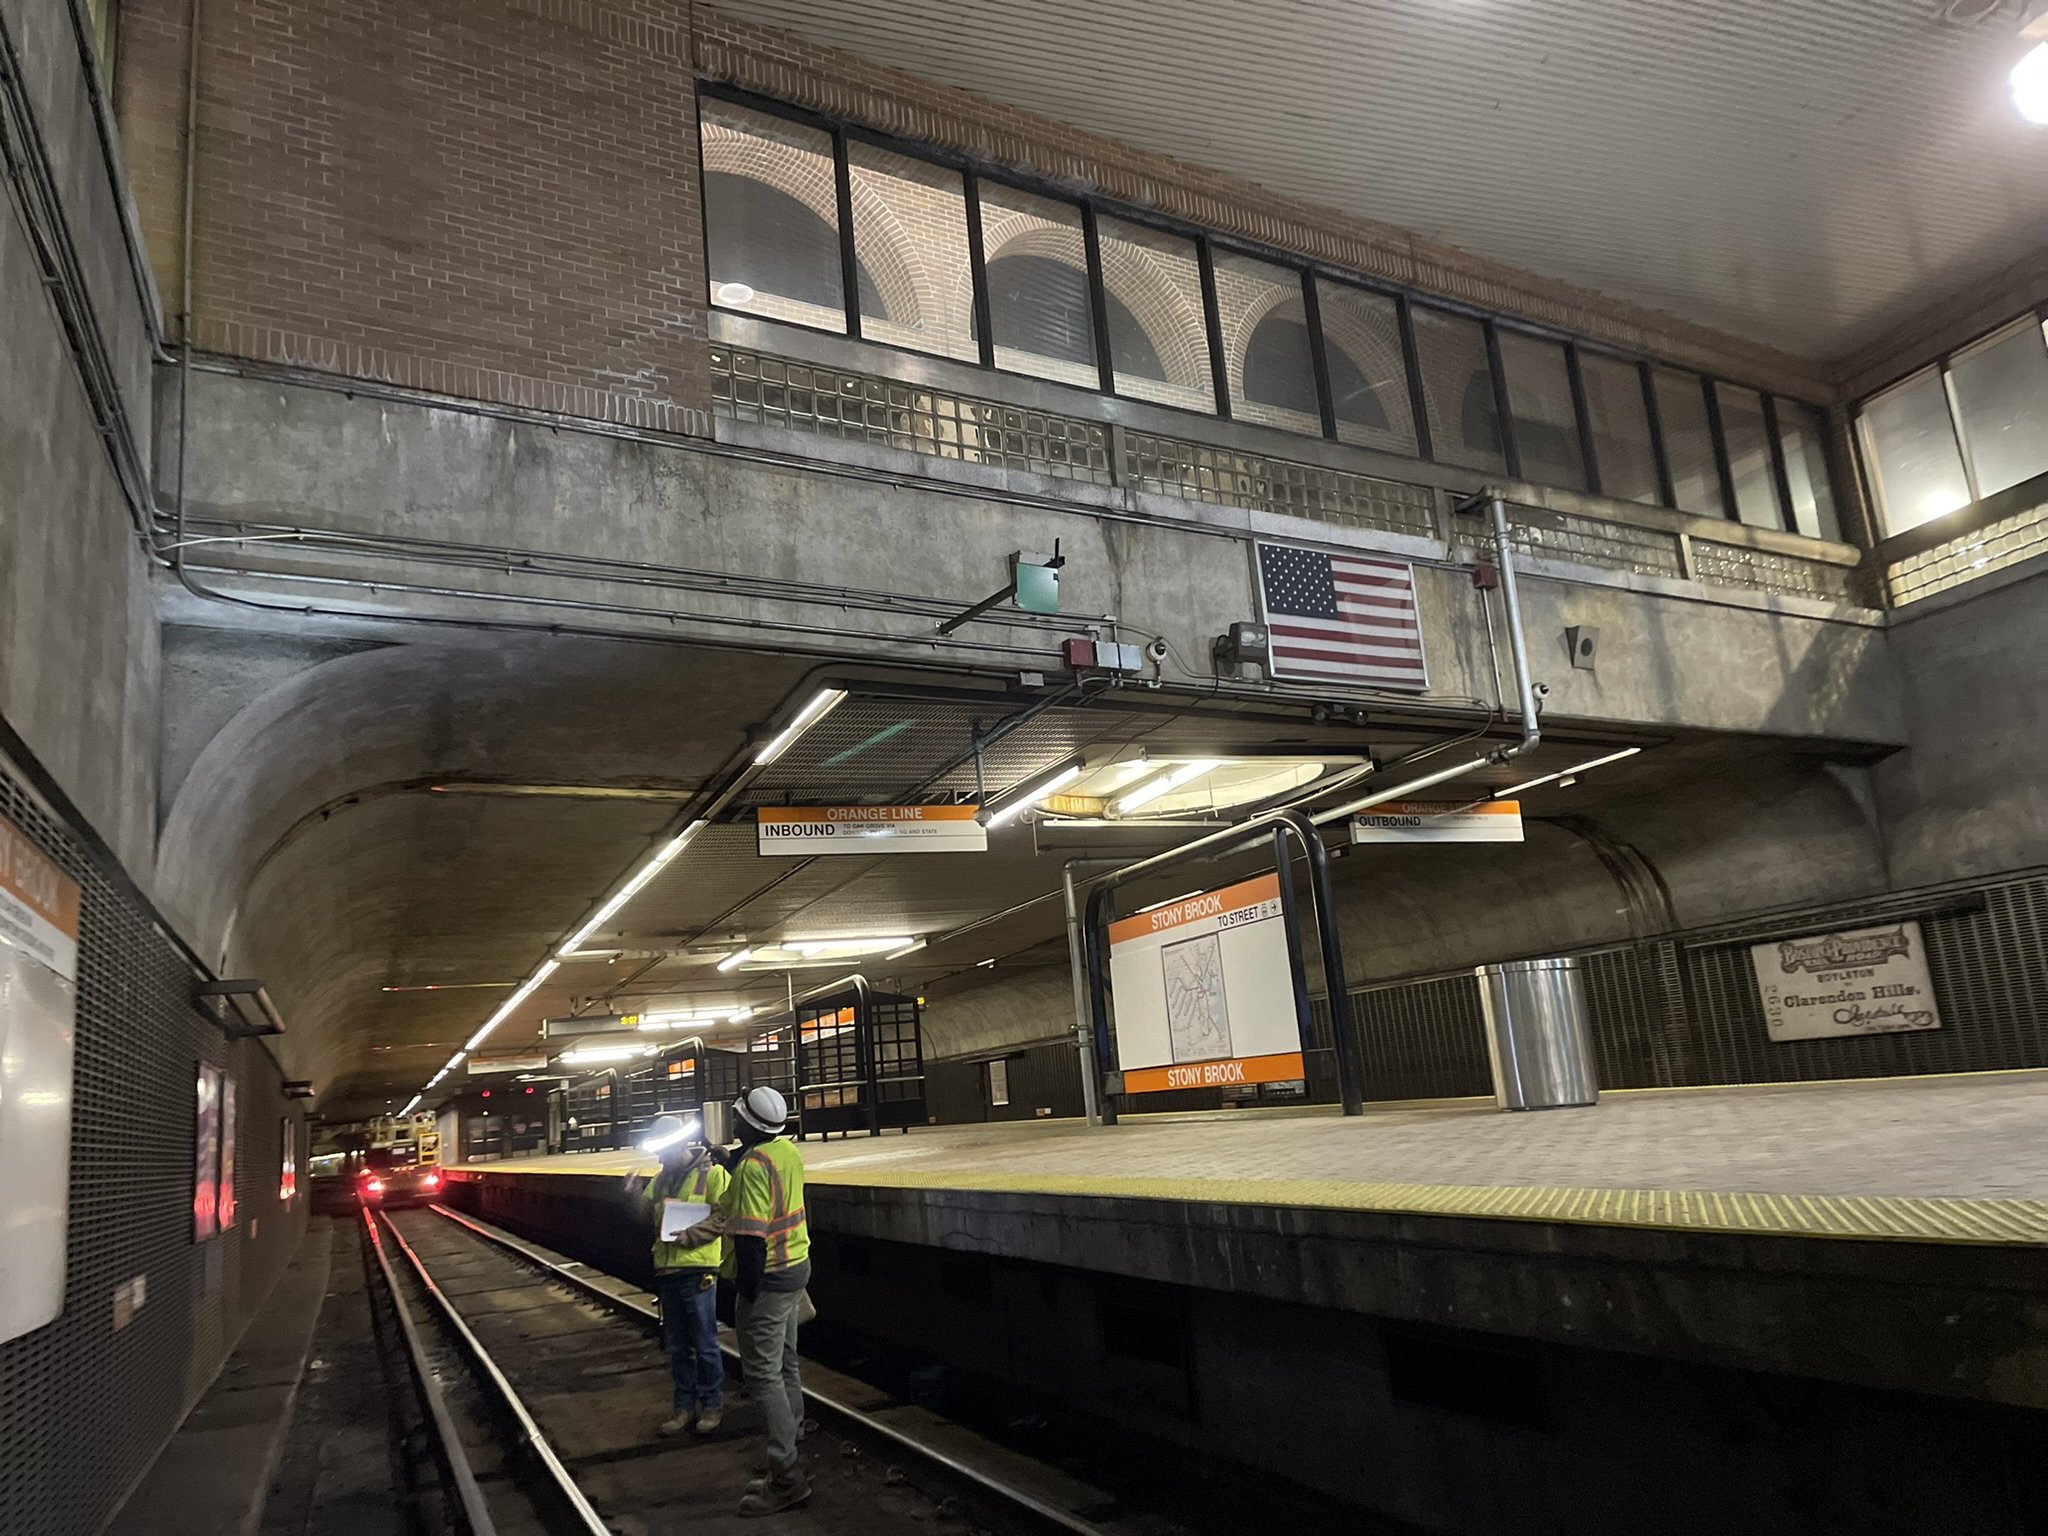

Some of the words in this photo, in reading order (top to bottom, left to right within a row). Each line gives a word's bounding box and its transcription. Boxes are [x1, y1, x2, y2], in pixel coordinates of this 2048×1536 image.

[827, 808, 887, 820] ORANGE
[892, 806, 923, 819] LINE
[1402, 802, 1448, 813] ORANGE
[765, 824, 835, 836] INBOUND
[1359, 816, 1421, 827] OUTBOUND
[1152, 908, 1182, 930] STONY
[1184, 895, 1223, 918] BROOK
[1218, 915, 1229, 928] TO
[1229, 906, 1259, 926] STREET
[1784, 989, 1867, 1008] Clarendon
[1871, 984, 1921, 1000] Hills.
[1167, 1068, 1203, 1087] STONY
[1204, 1063, 1245, 1083] BROOK
